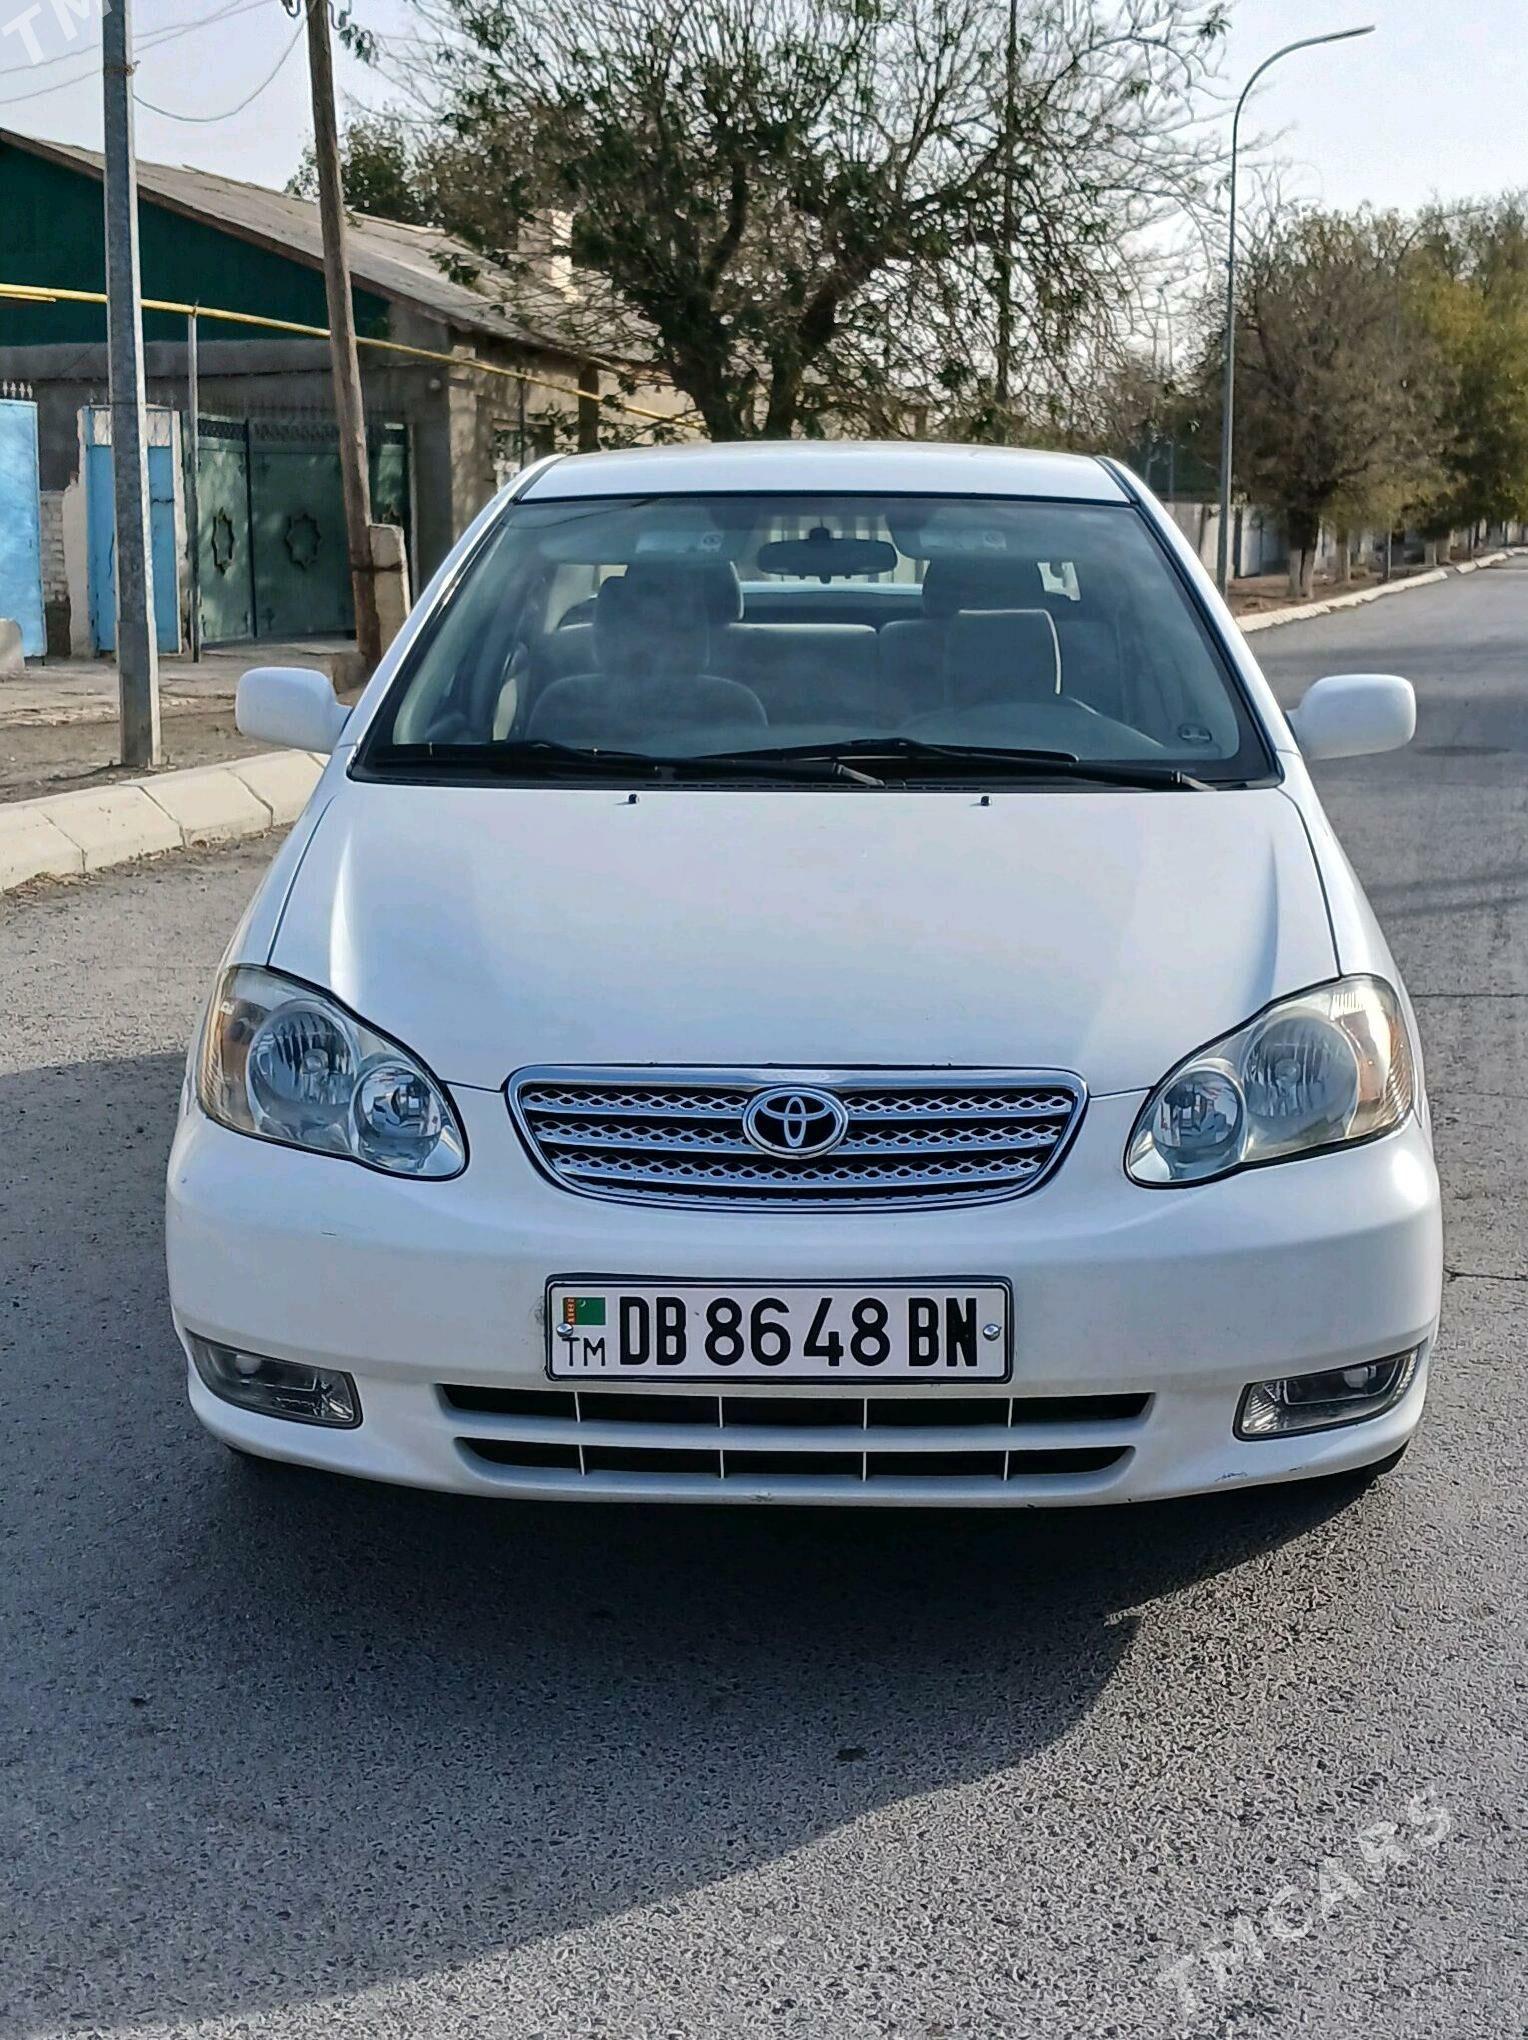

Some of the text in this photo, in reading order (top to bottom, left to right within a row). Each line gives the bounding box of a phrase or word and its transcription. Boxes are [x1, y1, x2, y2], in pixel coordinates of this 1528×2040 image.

[561, 1337, 606, 1368] TM
[619, 1296, 978, 1367] DB 8648 BN
